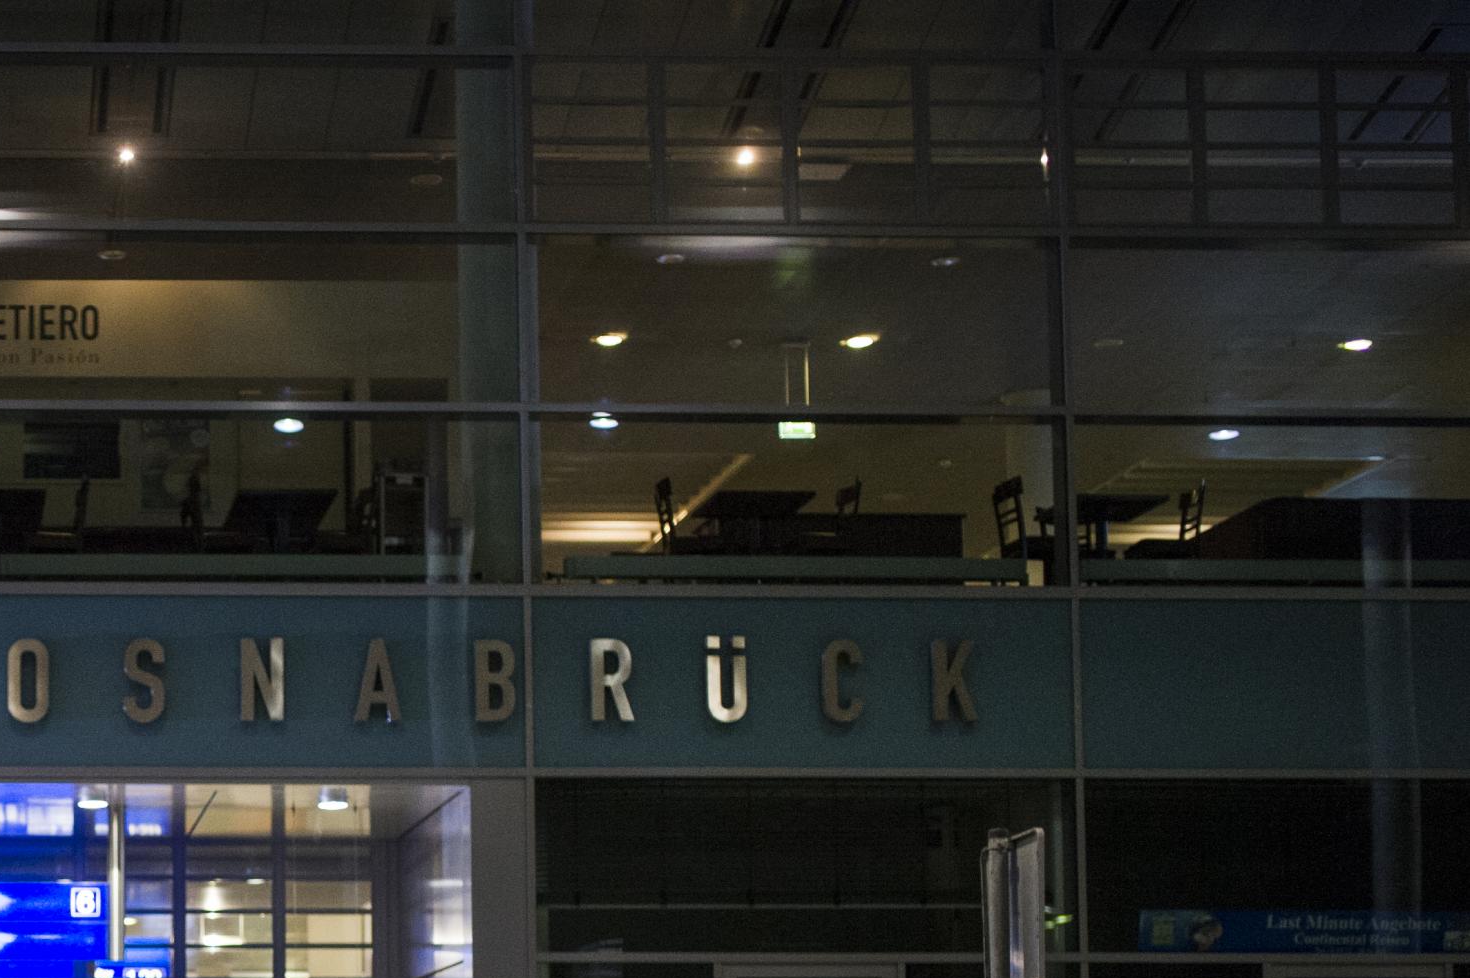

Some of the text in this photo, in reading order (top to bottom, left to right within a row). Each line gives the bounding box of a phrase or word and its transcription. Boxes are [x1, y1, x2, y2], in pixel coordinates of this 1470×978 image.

[5, 635, 978, 724] OSNABRÜCK
[1266, 913, 1442, 933] Last Minute Angebote
